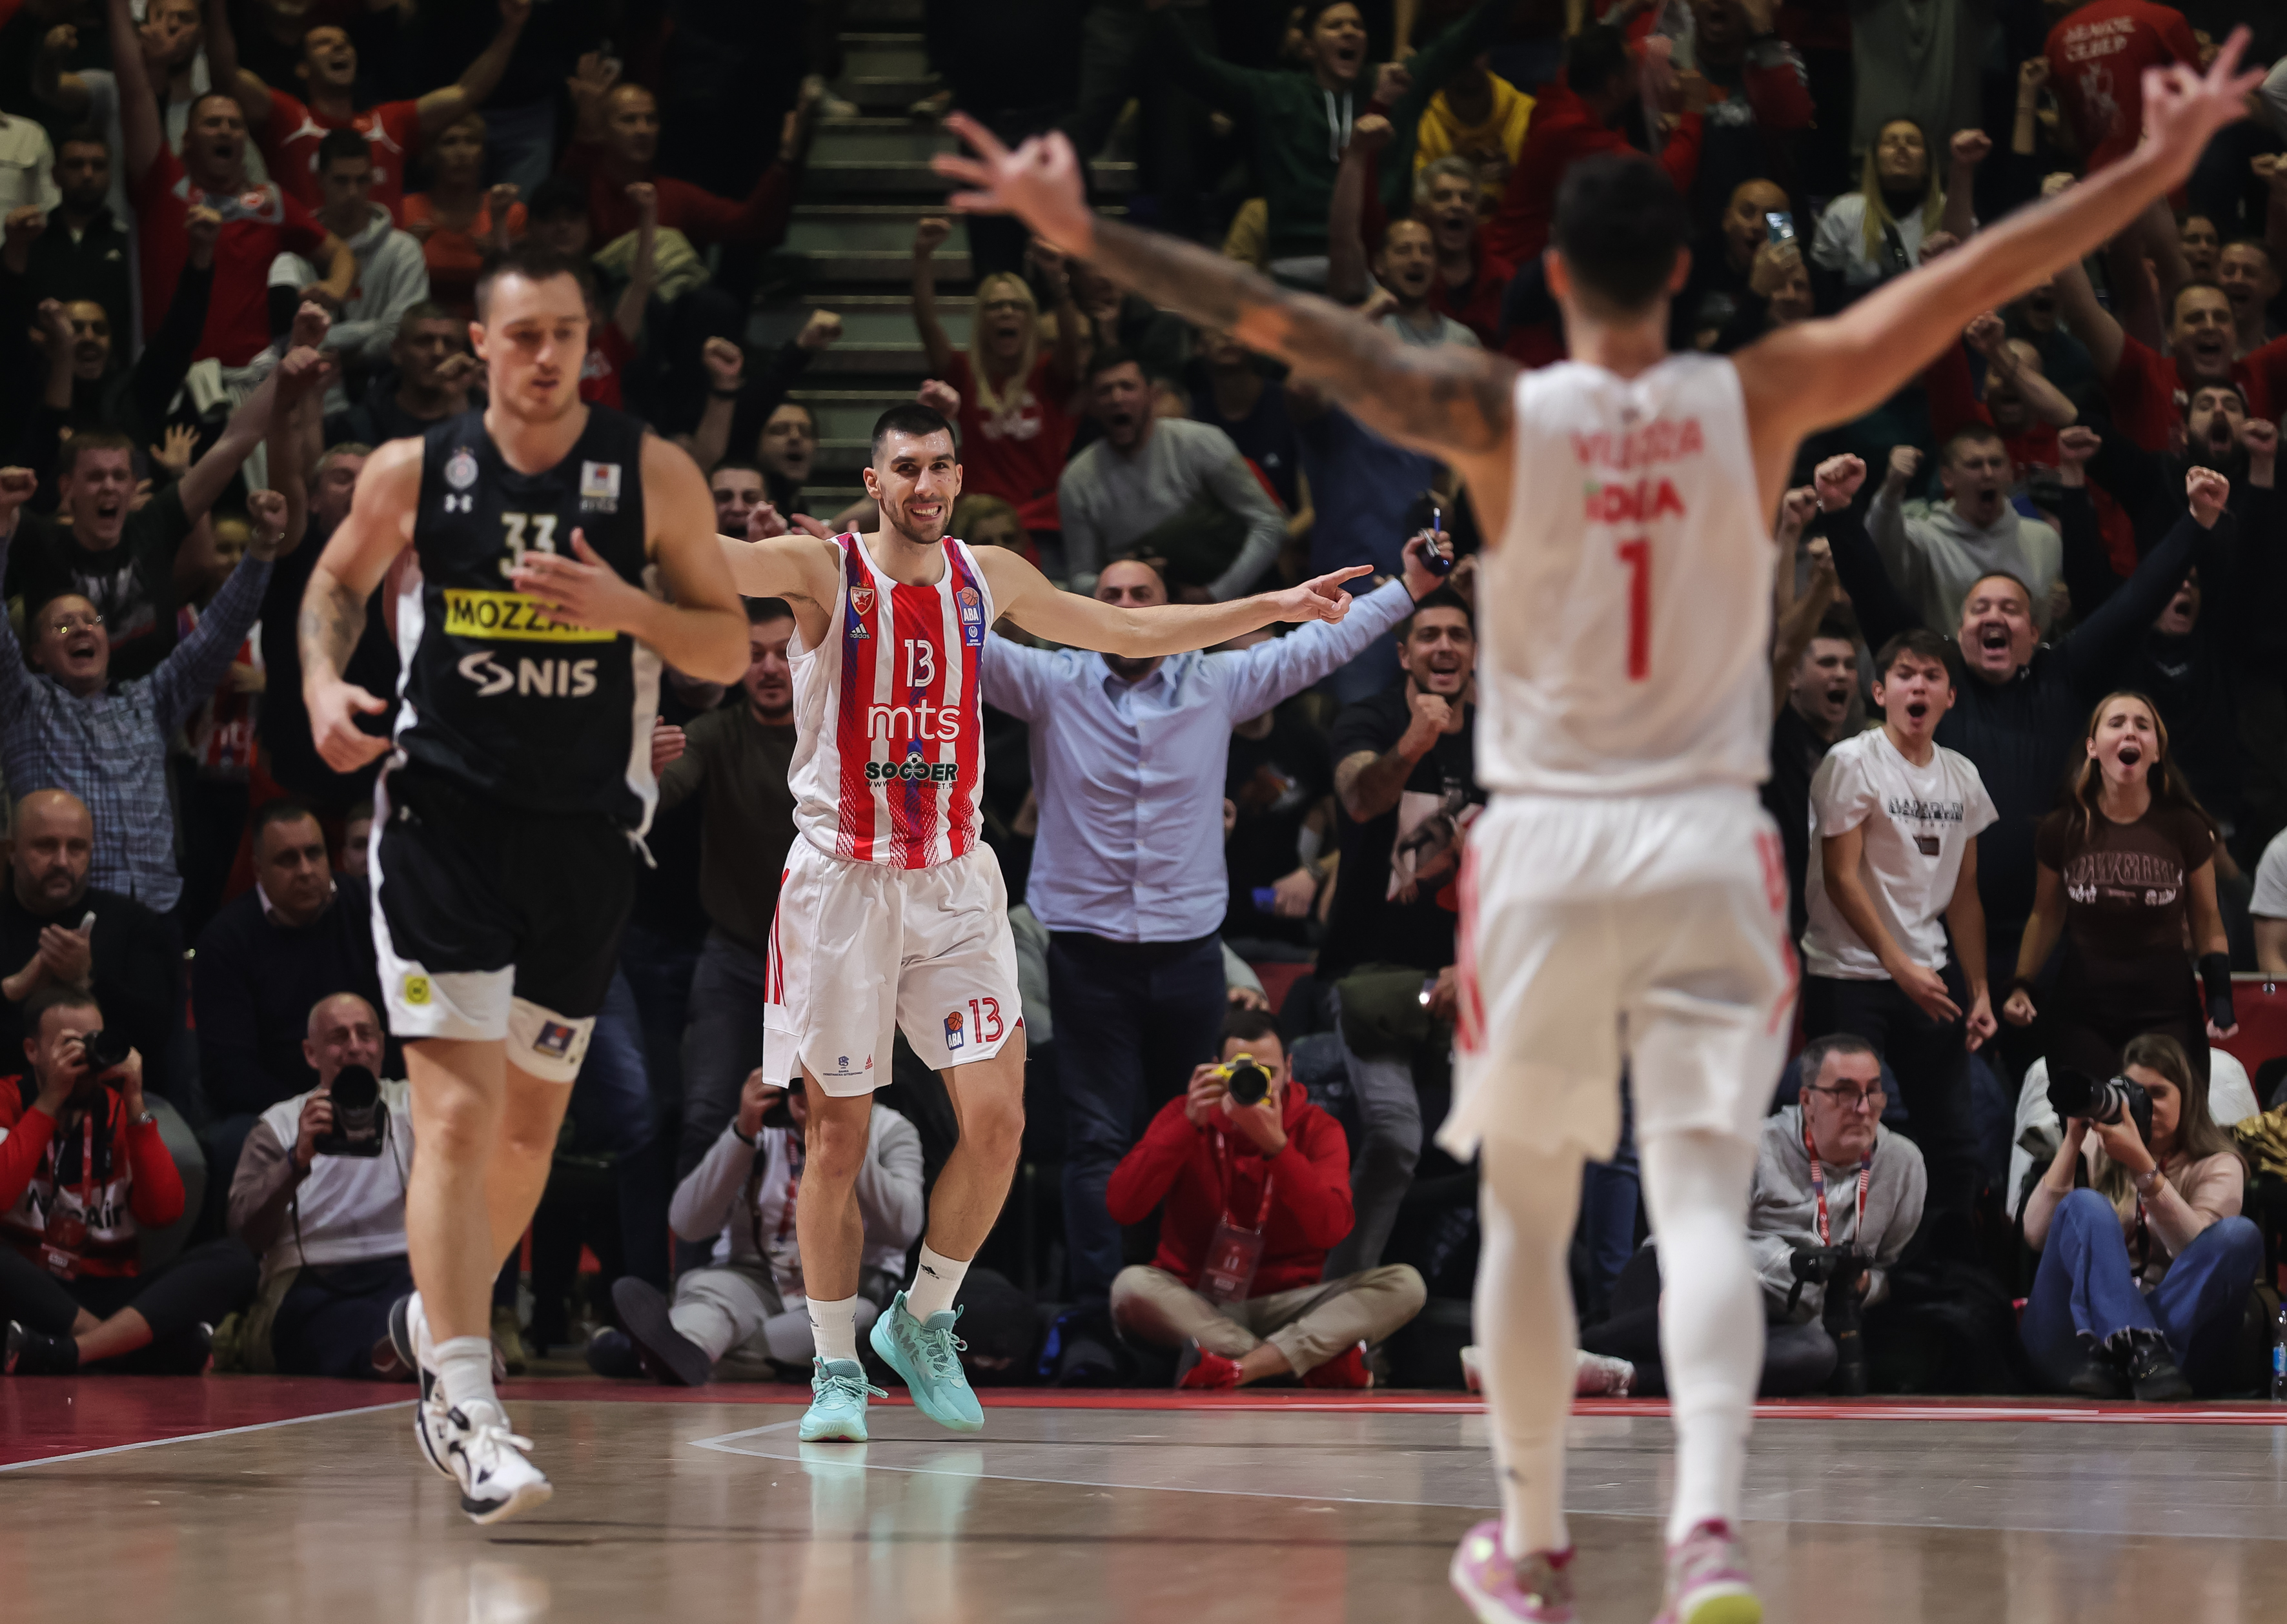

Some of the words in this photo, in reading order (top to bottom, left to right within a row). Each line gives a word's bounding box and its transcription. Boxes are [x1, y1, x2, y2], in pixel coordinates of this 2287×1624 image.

[499, 512, 558, 577] 33
[964, 607, 979, 622] ABA
[1618, 540, 1652, 682] 1
[518, 656, 598, 698] NIS
[905, 639, 935, 687] 13
[867, 699, 961, 740] mts
[864, 761, 959, 782] SOCCER
[948, 1031, 962, 1049] ABA
[968, 997, 1004, 1044] 13
